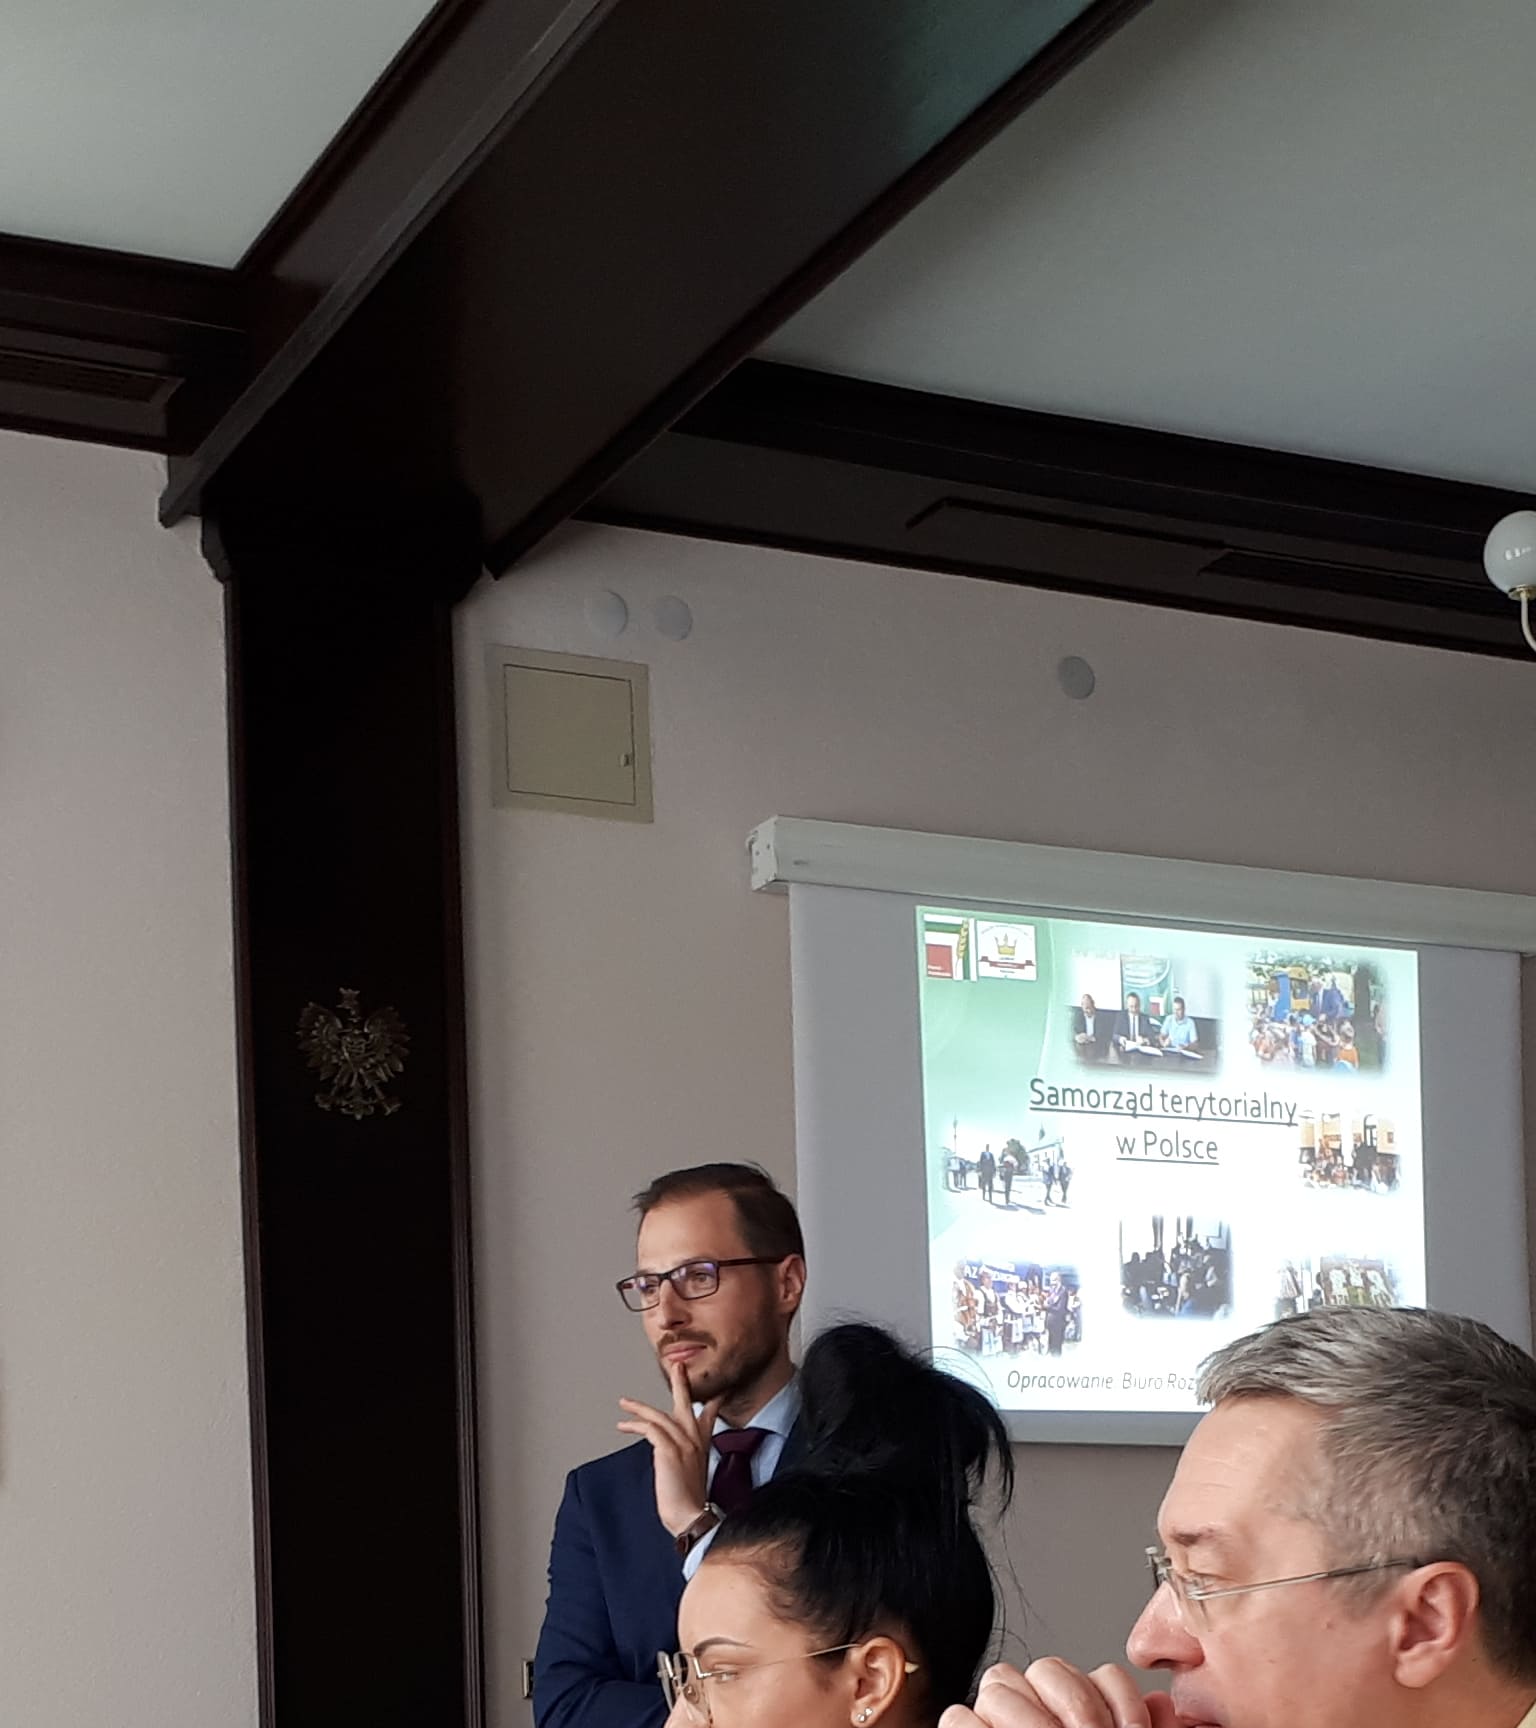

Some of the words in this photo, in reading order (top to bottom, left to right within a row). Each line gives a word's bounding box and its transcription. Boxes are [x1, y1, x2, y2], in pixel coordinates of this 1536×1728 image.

[1029, 1078, 1152, 1118] Samorząd
[1159, 1090, 1297, 1127] terytorialny
[1116, 1135, 1136, 1155] w
[1143, 1130, 1218, 1160] Polsce
[1007, 1370, 1114, 1393] Opracowanie
[1122, 1372, 1162, 1390] Biuro
